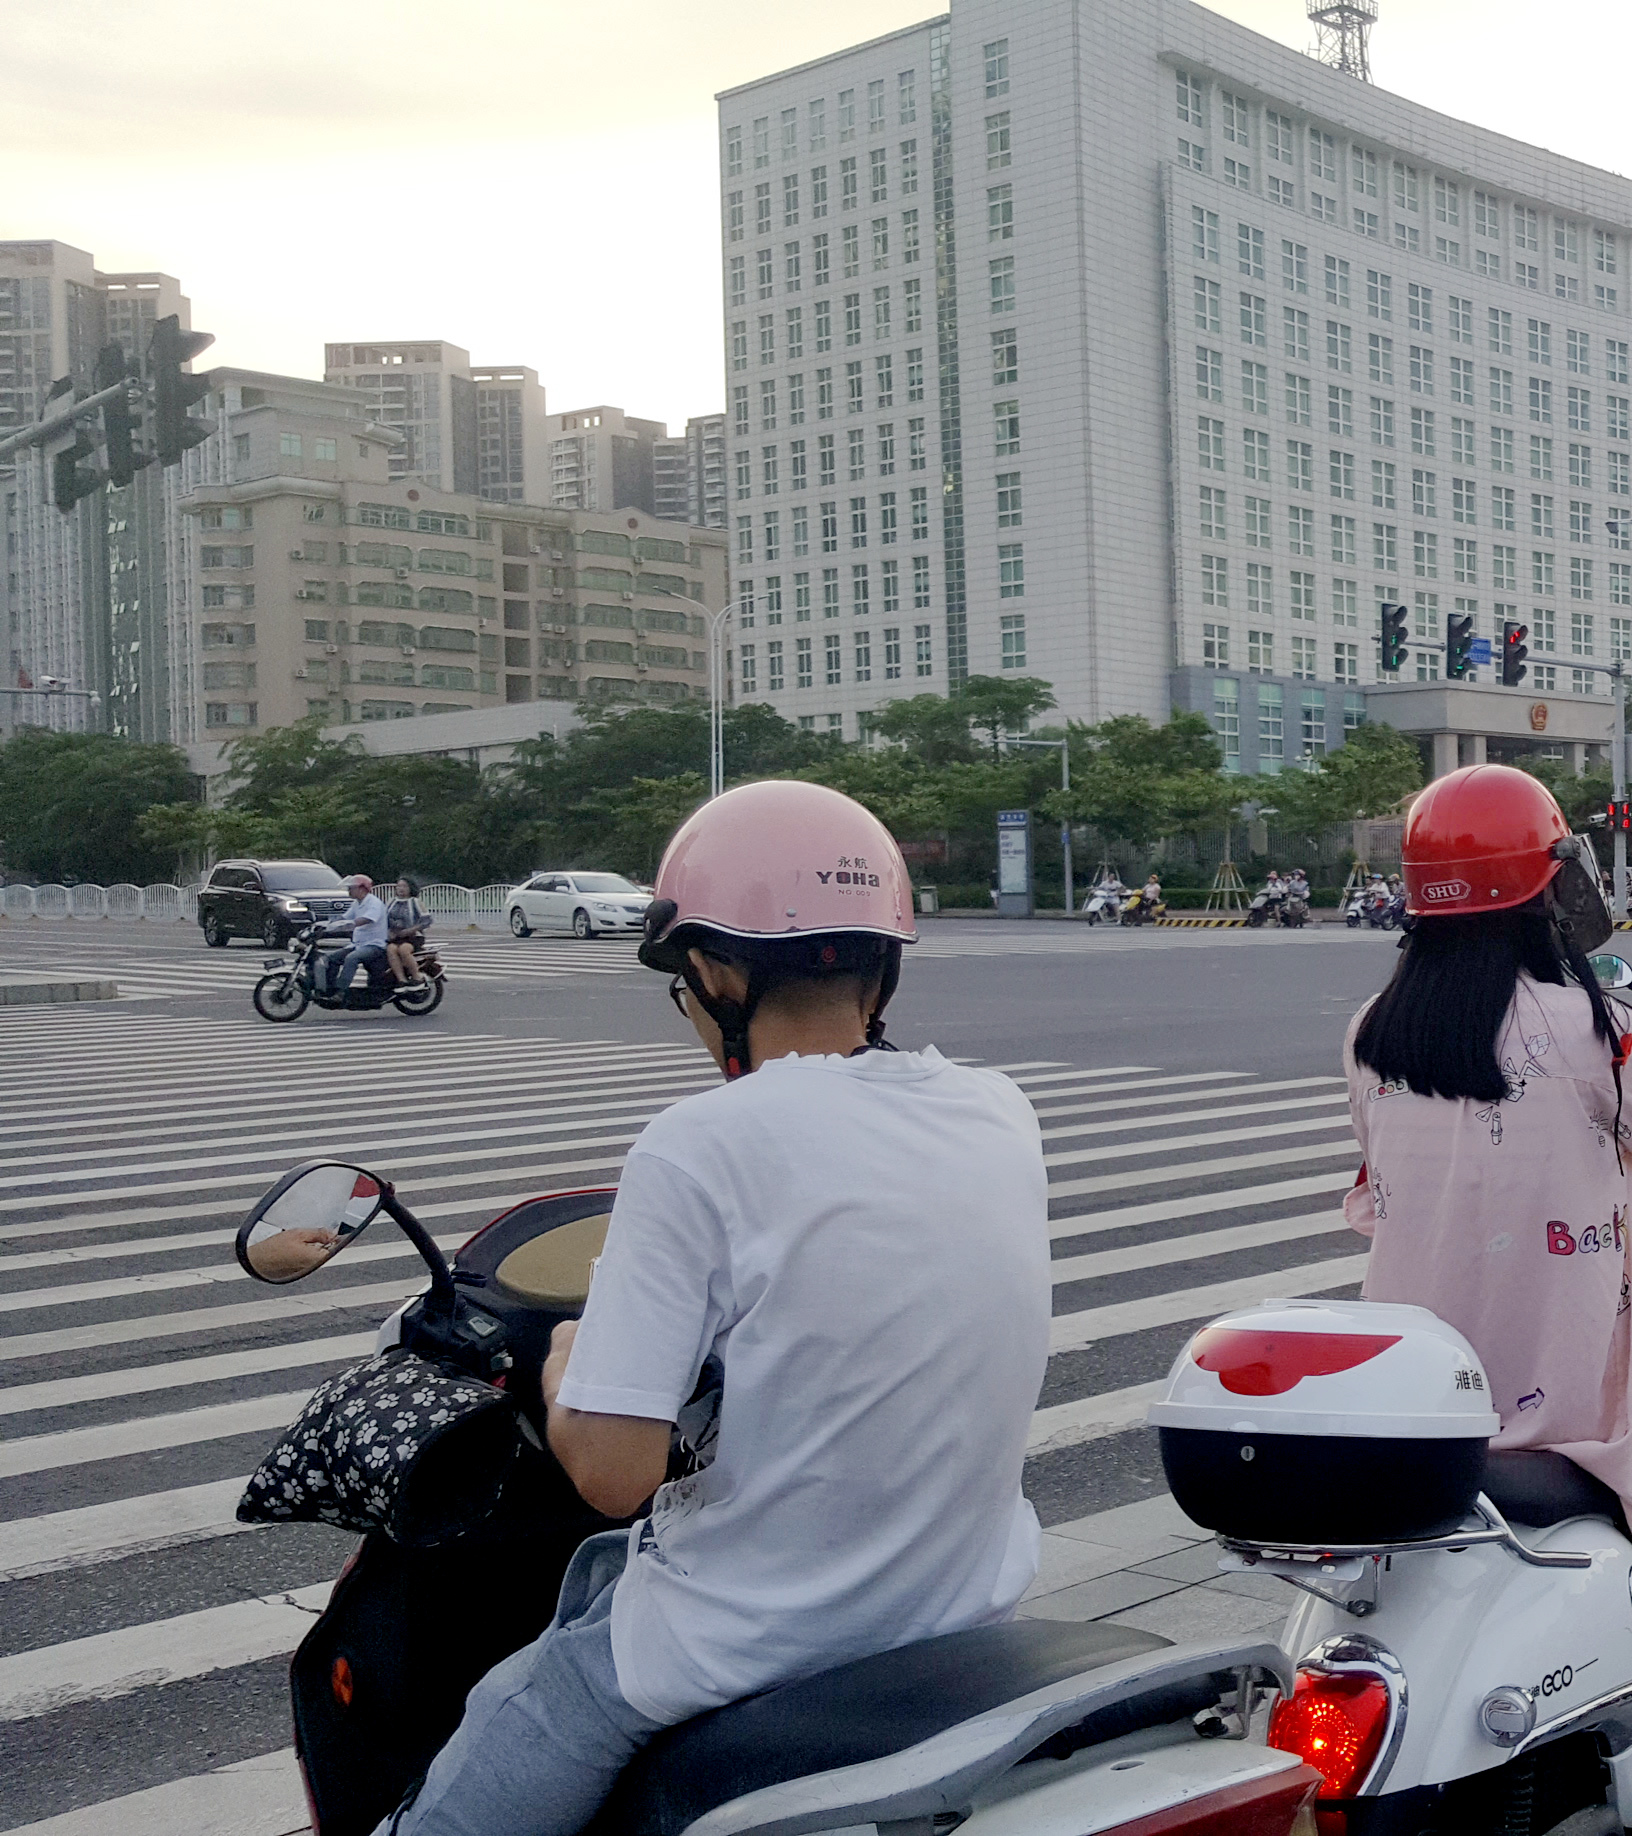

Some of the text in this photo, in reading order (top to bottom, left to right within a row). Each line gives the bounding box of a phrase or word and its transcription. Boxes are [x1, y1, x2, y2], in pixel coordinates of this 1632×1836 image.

[838, 856, 868, 869] 永航
[1427, 883, 1461, 899] SHU
[1453, 1369, 1484, 1391] 雅迪
[1542, 1665, 1573, 1697] eco
